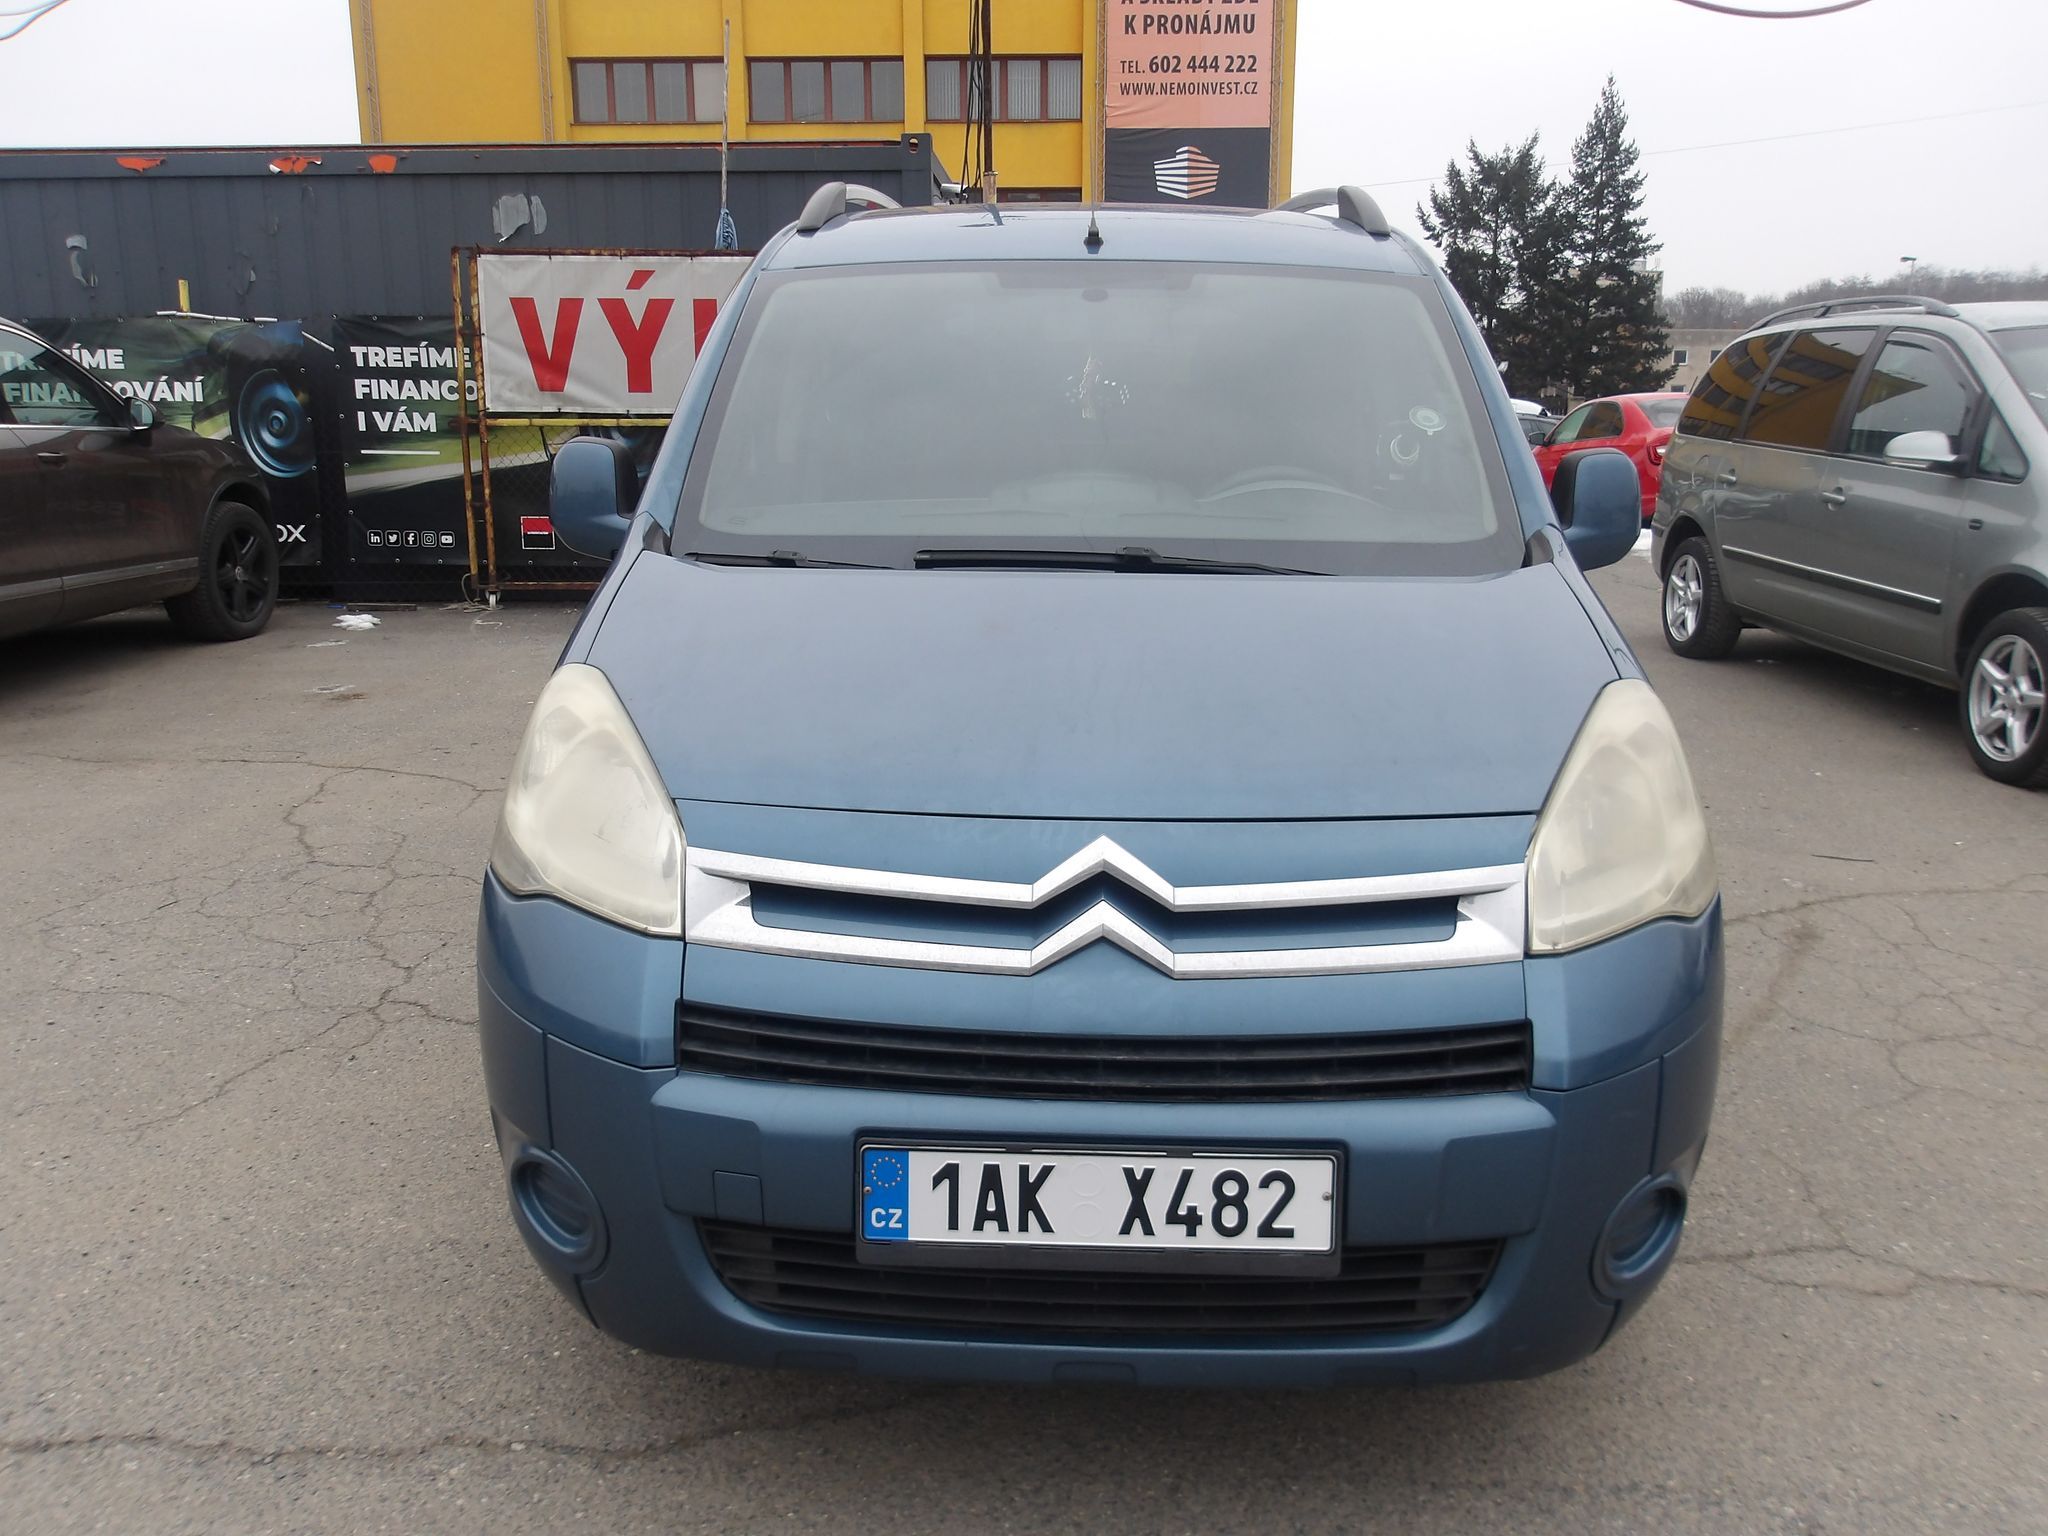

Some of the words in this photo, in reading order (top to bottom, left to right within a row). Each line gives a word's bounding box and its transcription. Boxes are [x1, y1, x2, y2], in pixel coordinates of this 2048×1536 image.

[1124, 14, 1136, 35] K
[1143, 10, 1256, 35] PRONÁJMU
[1120, 60, 1145, 74] TEL.
[1149, 55, 1181, 73] 602
[1187, 55, 1219, 73] 444
[1224, 54, 1257, 73] 222
[1120, 81, 1258, 96] WWW.NEMOINVEST.CZ
[0, 343, 125, 371] TRÍME
[350, 341, 472, 368] TREFÍME
[2, 375, 205, 402] FINAOVÁNÍ
[357, 411, 366, 431] I
[372, 406, 437, 432] VÁM
[930, 1161, 1056, 1233] 1AK
[1118, 1166, 1297, 1239] X482
[871, 1208, 902, 1229] CZ
